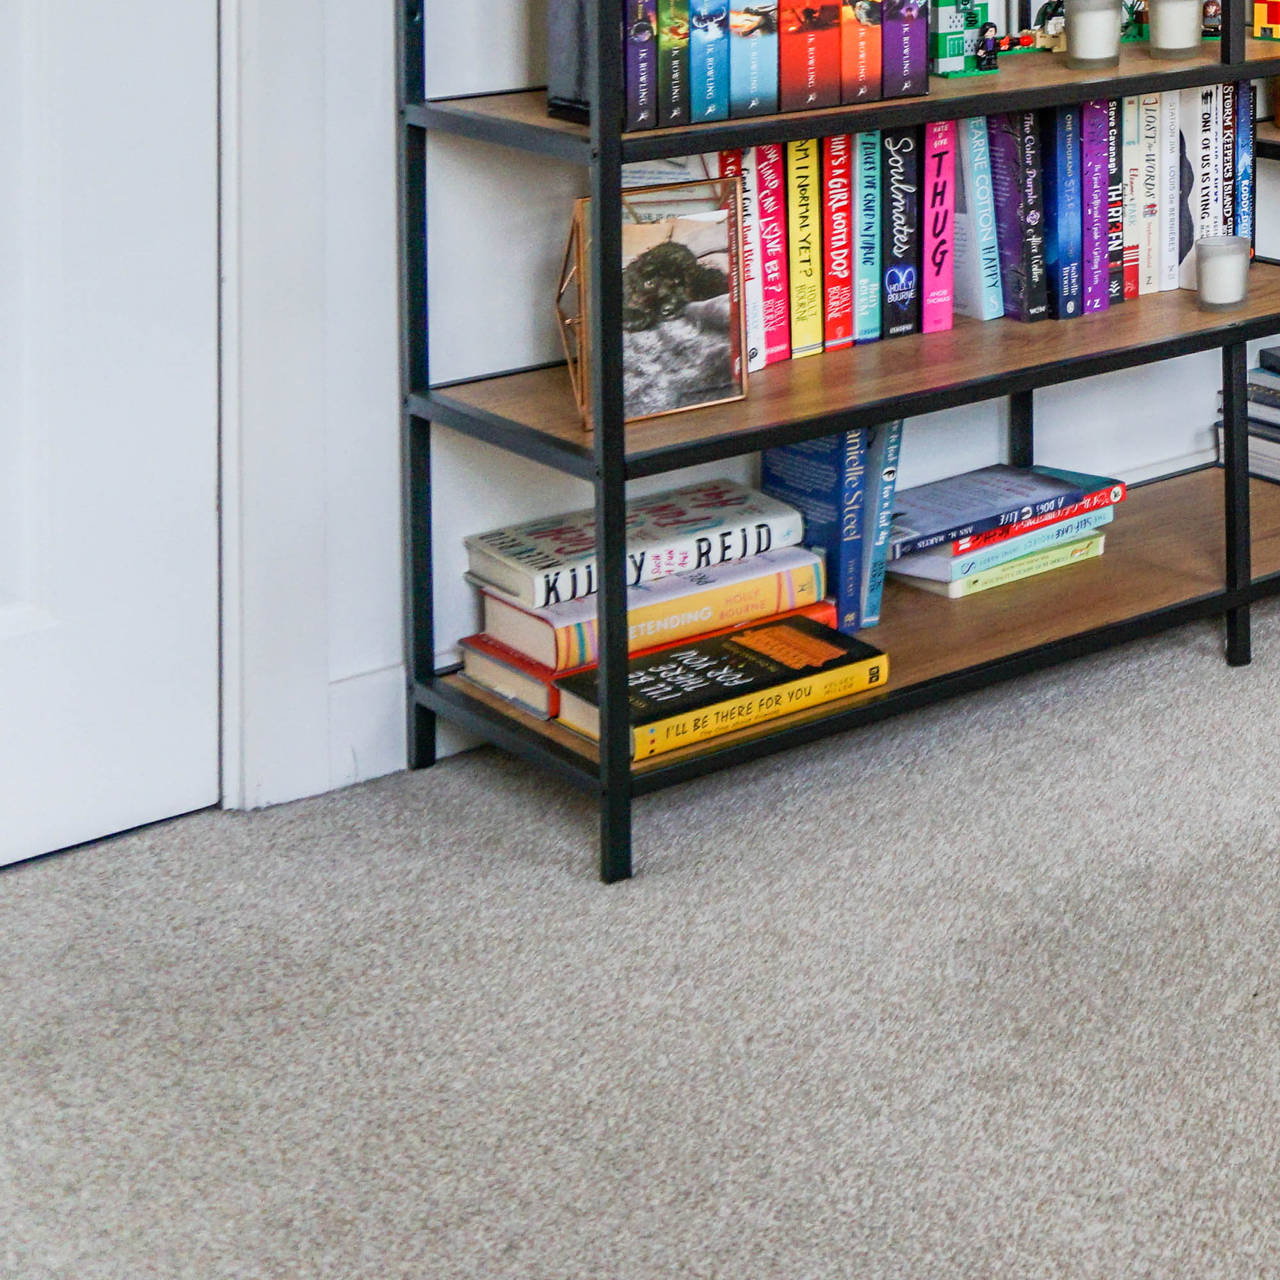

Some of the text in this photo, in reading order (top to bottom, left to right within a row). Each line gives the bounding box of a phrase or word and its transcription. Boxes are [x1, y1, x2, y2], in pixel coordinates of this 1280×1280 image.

[808, 47, 816, 88] ROWLING
[858, 41, 867, 82] ROWLING
[903, 37, 911, 77] ROWLING
[639, 63, 649, 106] ROWLING
[672, 60, 680, 103] ROWLING
[706, 57, 715, 99] ROWLING
[1169, 102, 1177, 138] STATION
[1201, 112, 1211, 133] ONE
[1223, 85, 1234, 126] STORM
[1108, 101, 1118, 174] Steve Cavanagh
[1144, 108, 1157, 199] LOST WORDS
[1201, 138, 1211, 151] OF
[832, 169, 846, 177] A
[1024, 112, 1038, 205] The Color Purple
[1201, 154, 1211, 169] US
[828, 178, 848, 212] GIRL
[1168, 166, 1176, 192] LOUIS
[1201, 172, 1211, 184] IS
[759, 189, 780, 214] CAN
[796, 175, 810, 229] NORMAL
[884, 137, 917, 258] Soulmates
[970, 116, 1000, 289] EARNE COTTON HAPPY
[1200, 186, 1211, 220] LYING
[1223, 179, 1234, 218] ISLAND
[1241, 180, 1249, 214] RODDY
[831, 212, 848, 249] GOTTA
[864, 221, 875, 232] IN
[799, 233, 813, 278] YET?
[828, 249, 849, 278] DO?
[840, 286, 852, 314] HOLLY
[887, 289, 917, 303] BOURNE
[889, 280, 913, 292] HOLLY
[773, 299, 786, 327] HOLLY
[843, 430, 864, 542] anielle Steel
[1000, 510, 1019, 526] LIFE
[628, 606, 713, 639] ETENDING
[665, 723, 688, 739] I'LL
[692, 717, 709, 732] BE
[713, 703, 753, 726] THERE
[758, 696, 783, 713] FOR
[787, 686, 813, 704] YOU
